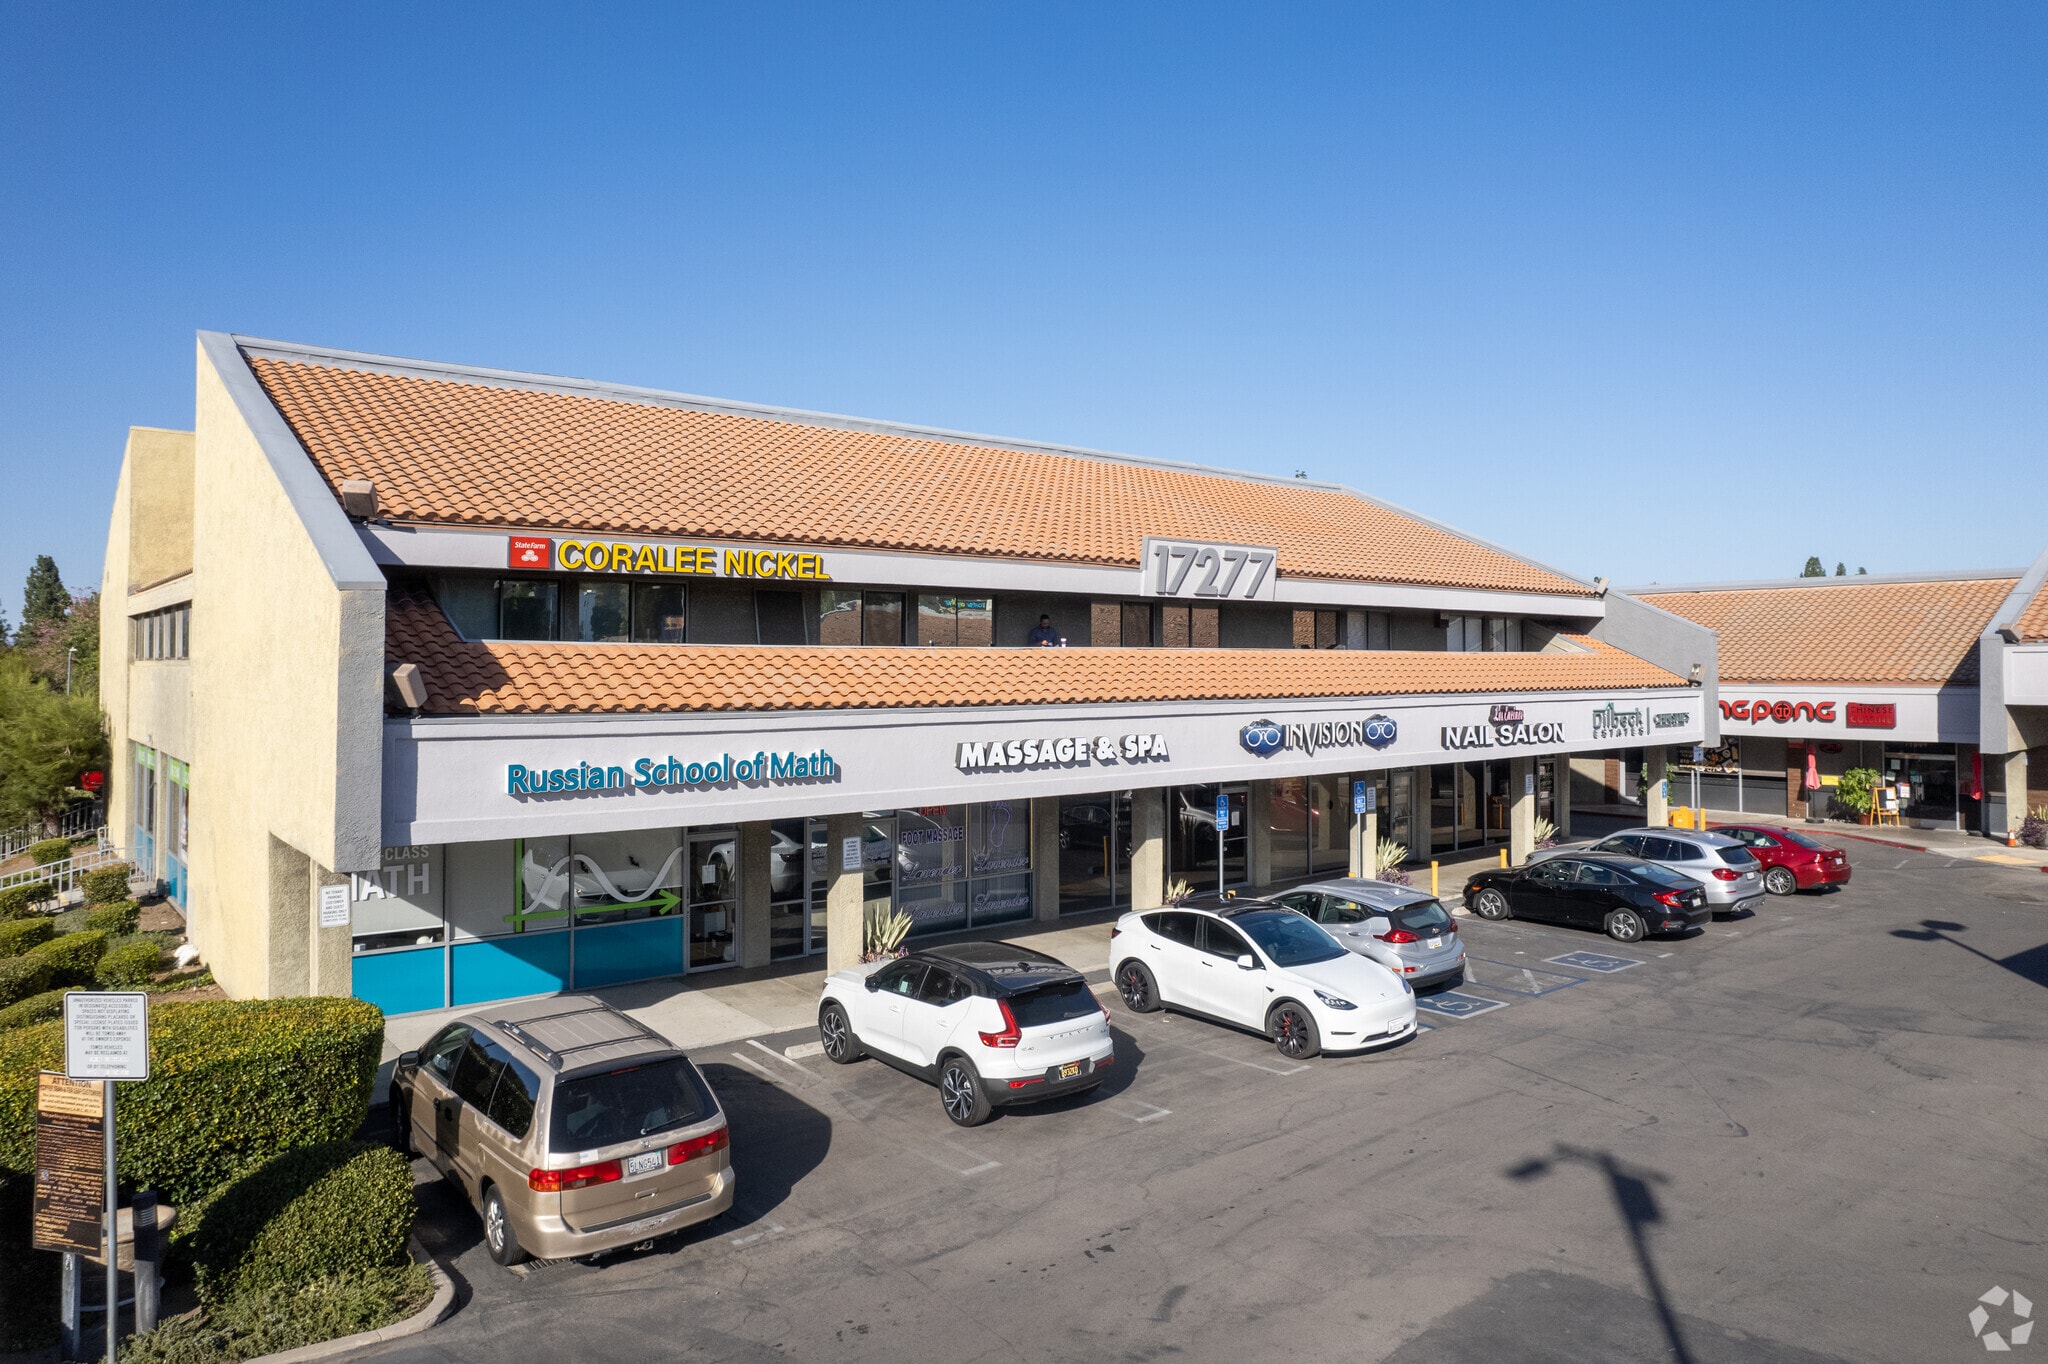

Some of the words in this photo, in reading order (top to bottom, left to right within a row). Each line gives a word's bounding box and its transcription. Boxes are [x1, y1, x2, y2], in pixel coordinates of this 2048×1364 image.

[558, 540, 714, 574] CORALEE
[725, 549, 830, 579] NICKEL
[1154, 545, 1274, 598] 17277
[1593, 706, 1643, 729] Dilbeck
[1851, 706, 1893, 714] CHINESE
[1851, 716, 1893, 724] CUISINE
[1285, 721, 1363, 754] INVISION
[1446, 724, 1494, 747] NAIL
[1500, 722, 1566, 744] SALON
[1593, 727, 1644, 740] ESTATES
[959, 736, 1089, 768] MASSAGE
[1096, 736, 1116, 760] &
[1126, 734, 1167, 758] SPA
[507, 761, 625, 795] Russian
[634, 753, 729, 787] School
[735, 751, 765, 780] of
[770, 749, 835, 778] Math
[918, 804, 946, 817] OPEN
[902, 830, 924, 847] FOOT
[926, 826, 964, 843] MASSAGE
[381, 845, 429, 860] -CLASS
[974, 851, 1029, 871] Lavender
[902, 860, 963, 881] Lavender
[975, 891, 1029, 912] Lavender
[52, 1077, 91, 1088] ATTENTION
